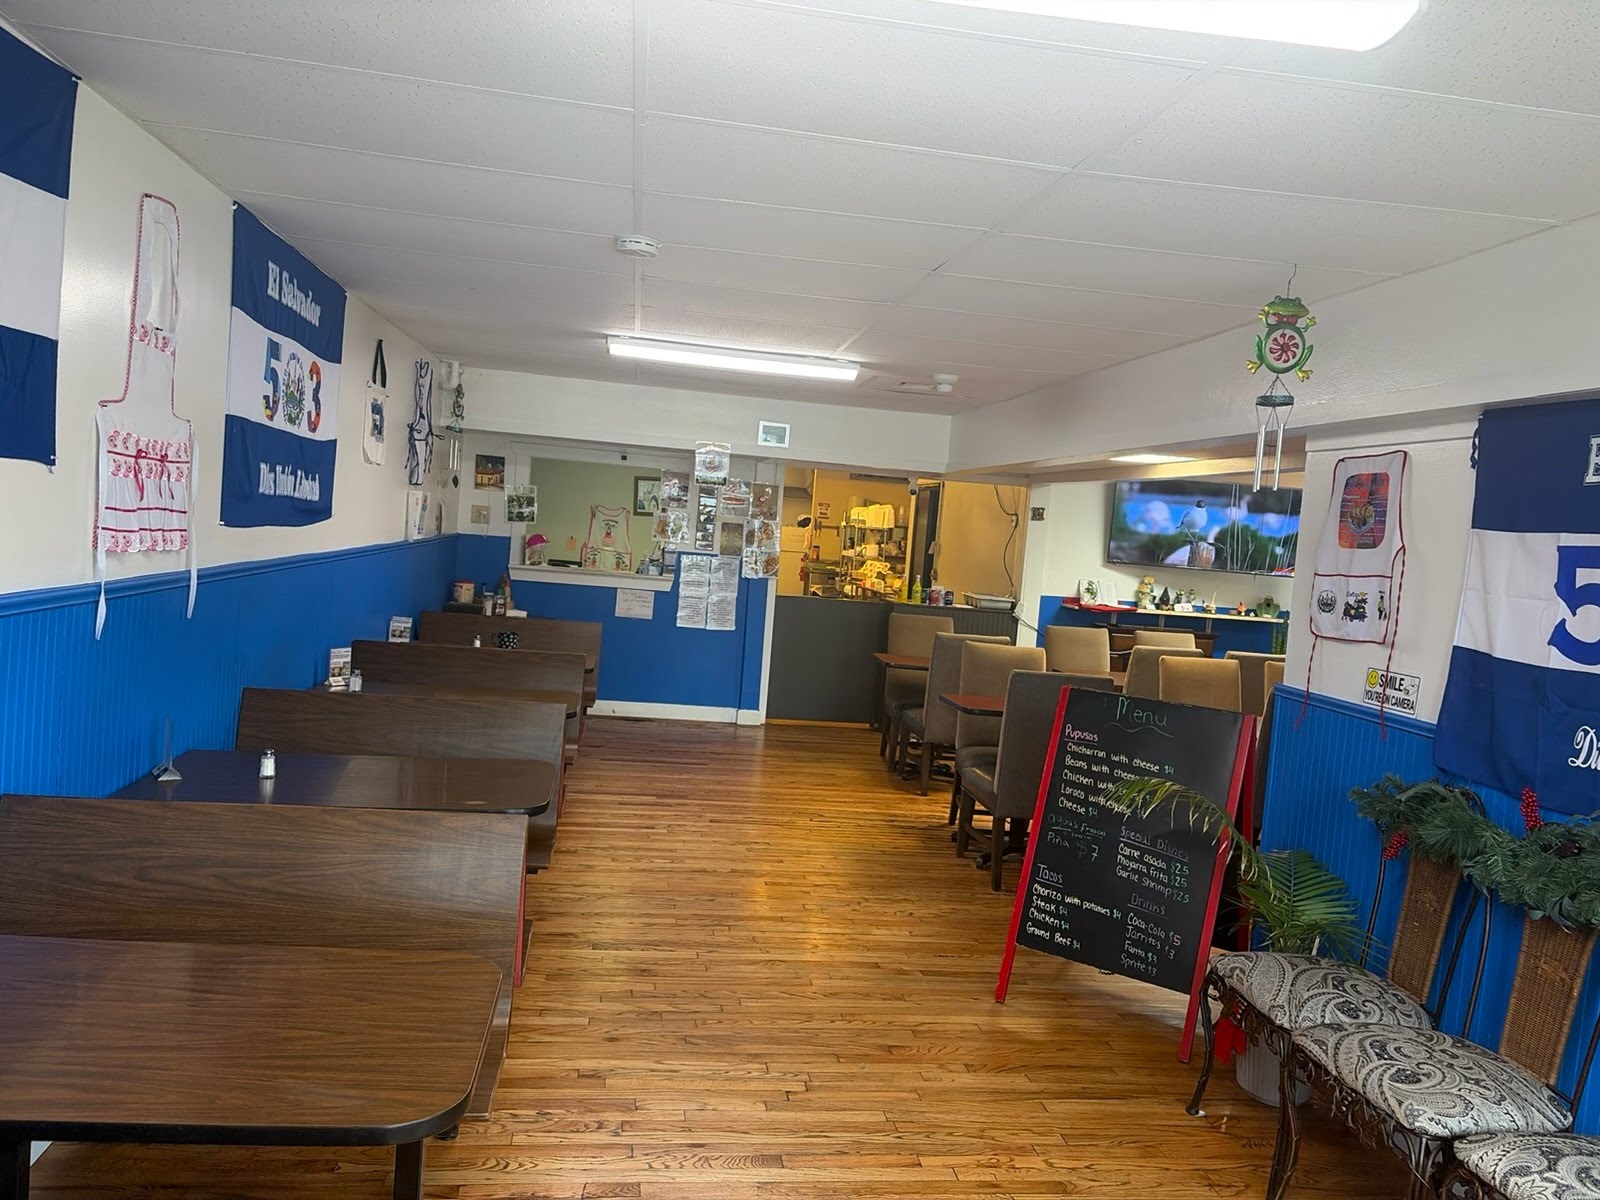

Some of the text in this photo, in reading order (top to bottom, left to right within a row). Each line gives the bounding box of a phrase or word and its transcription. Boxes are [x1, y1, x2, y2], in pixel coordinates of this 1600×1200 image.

[267, 260, 322, 328] El Salvador
[1379, 673, 1405, 692] SMILE
[1116, 697, 1168, 727] Menu
[1390, 695, 1415, 712] CAMERA
[1065, 724, 1098, 742] Pupusas
[1065, 755, 1088, 771] Beans
[1091, 763, 1110, 775] with
[1067, 742, 1106, 759] Chicharron
[1111, 753, 1129, 765] with
[1132, 758, 1160, 773] cheese
[1062, 769, 1094, 787] Chicken
[1060, 783, 1085, 800] Loroco
[1058, 797, 1098, 818] Cheese $4
[1047, 831, 1070, 848] Piña
[1120, 826, 1189, 860] Special Dishes
[1118, 843, 1141, 859] Carne
[1143, 854, 1167, 869] asada
[1037, 863, 1064, 881] Tacos
[1116, 865, 1139, 882] Garlic
[1149, 866, 1168, 883] frita
[1032, 883, 1062, 901] Chorizo
[1064, 893, 1081, 906] with
[1112, 908, 1122, 920] $4
[1032, 896, 1068, 917] Steak $4
[1131, 893, 1166, 915] Drinks
[1028, 907, 1060, 928] Chicken
[1127, 912, 1166, 939] Coca-Cola
[1026, 922, 1050, 940] Ground
[1055, 932, 1072, 947] Beef
[1125, 925, 1161, 950] Jarritos
[1124, 940, 1146, 958] Fanta
[1120, 953, 1146, 972] Sprite
